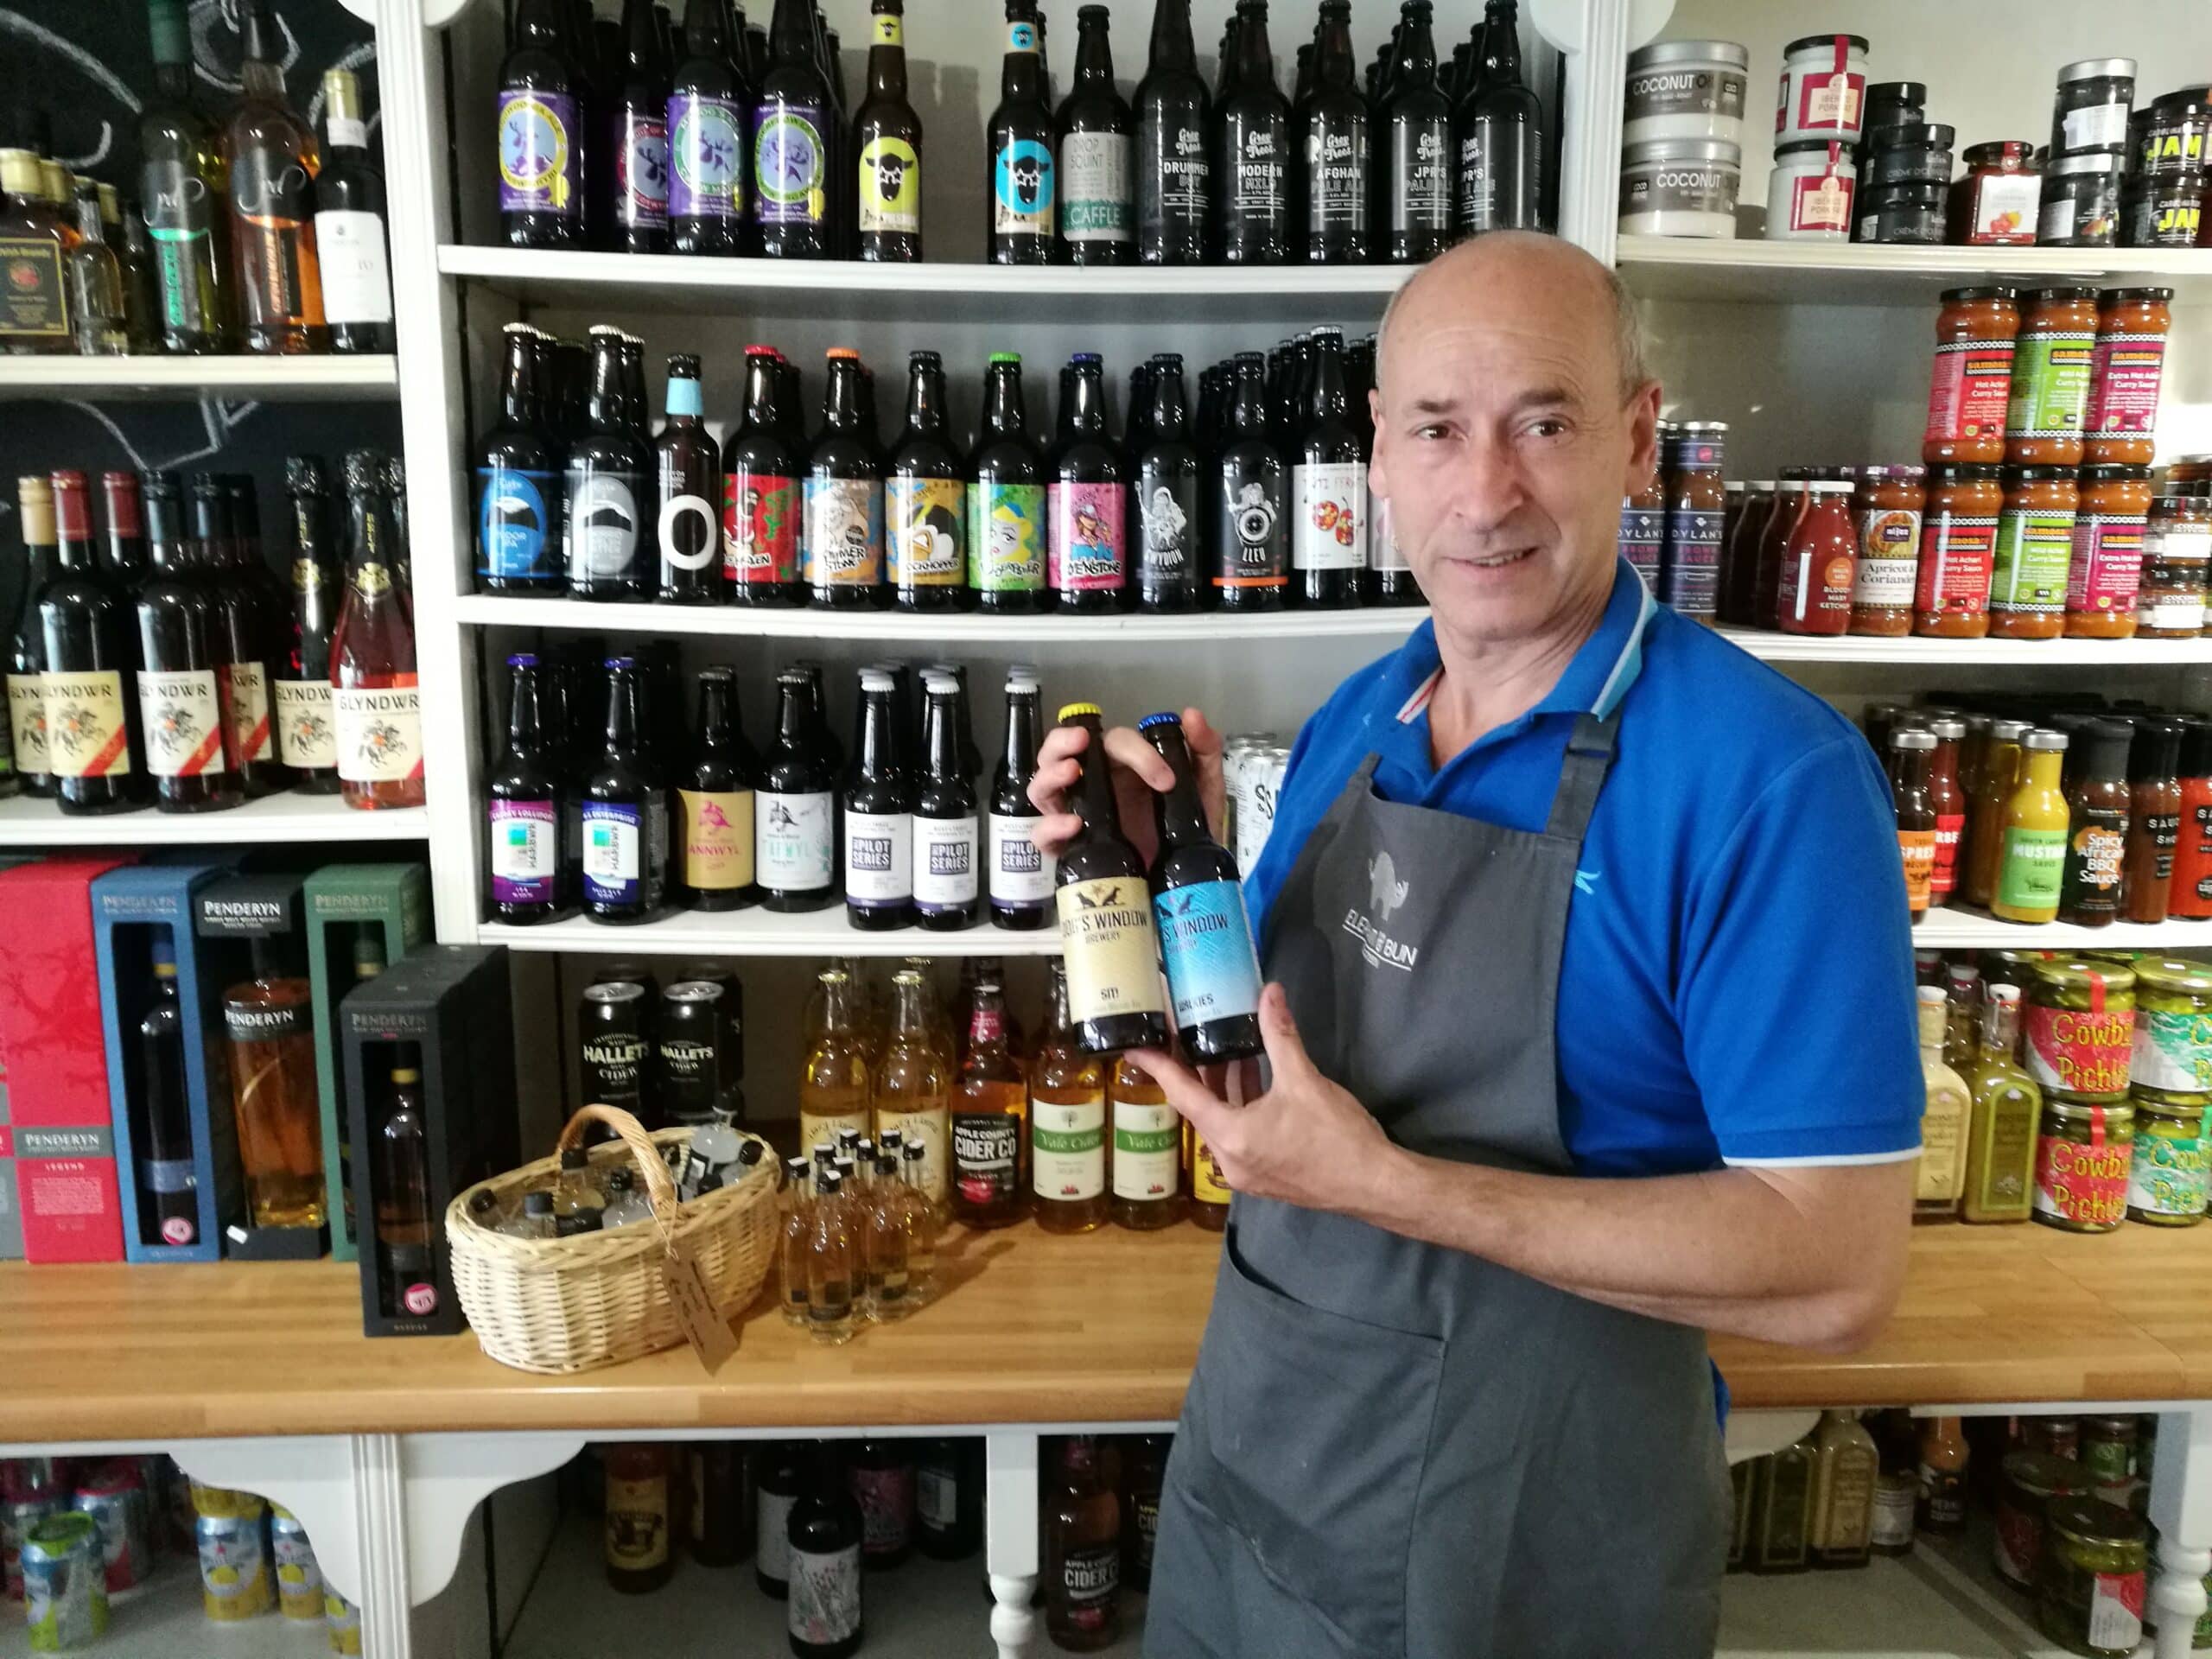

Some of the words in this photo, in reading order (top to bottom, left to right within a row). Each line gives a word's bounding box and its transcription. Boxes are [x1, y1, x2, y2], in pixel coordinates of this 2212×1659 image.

[1633, 74, 1694, 96] COCONUT
[2146, 135, 2202, 162] JAM
[1163, 162, 1209, 175] DRUMMER
[1237, 164, 1283, 178] MODERN
[1316, 167, 1362, 180] AFGHAN
[1656, 172, 1720, 188] COCONUT
[1071, 207, 1121, 225] CAFFLE
[2158, 208, 2201, 234] JAM
[1866, 563, 1907, 575] Apricot
[340, 693, 420, 711] GLYNDWR
[858, 838, 890, 853] PILOT
[2088, 833, 2125, 849] Spicy
[939, 842, 969, 858] PILOT
[2077, 846, 2126, 859] African
[852, 852, 890, 866] SERIES
[931, 856, 969, 872] SERIES
[1002, 854, 1040, 868] SERIES
[2087, 858, 2117, 873] BBQ
[2079, 869, 2120, 885] Sauce
[205, 900, 281, 917] PENDERYN
[1095, 910, 1148, 930] WINDOW
[1084, 931, 1122, 944] BREWERY
[225, 1009, 294, 1027] PENDERYN
[24, 1132, 99, 1147] PENDERYN
[954, 1135, 995, 1160] CIDER
[997, 1136, 1017, 1158] CO
[1065, 1568, 1107, 1587] CIDER
